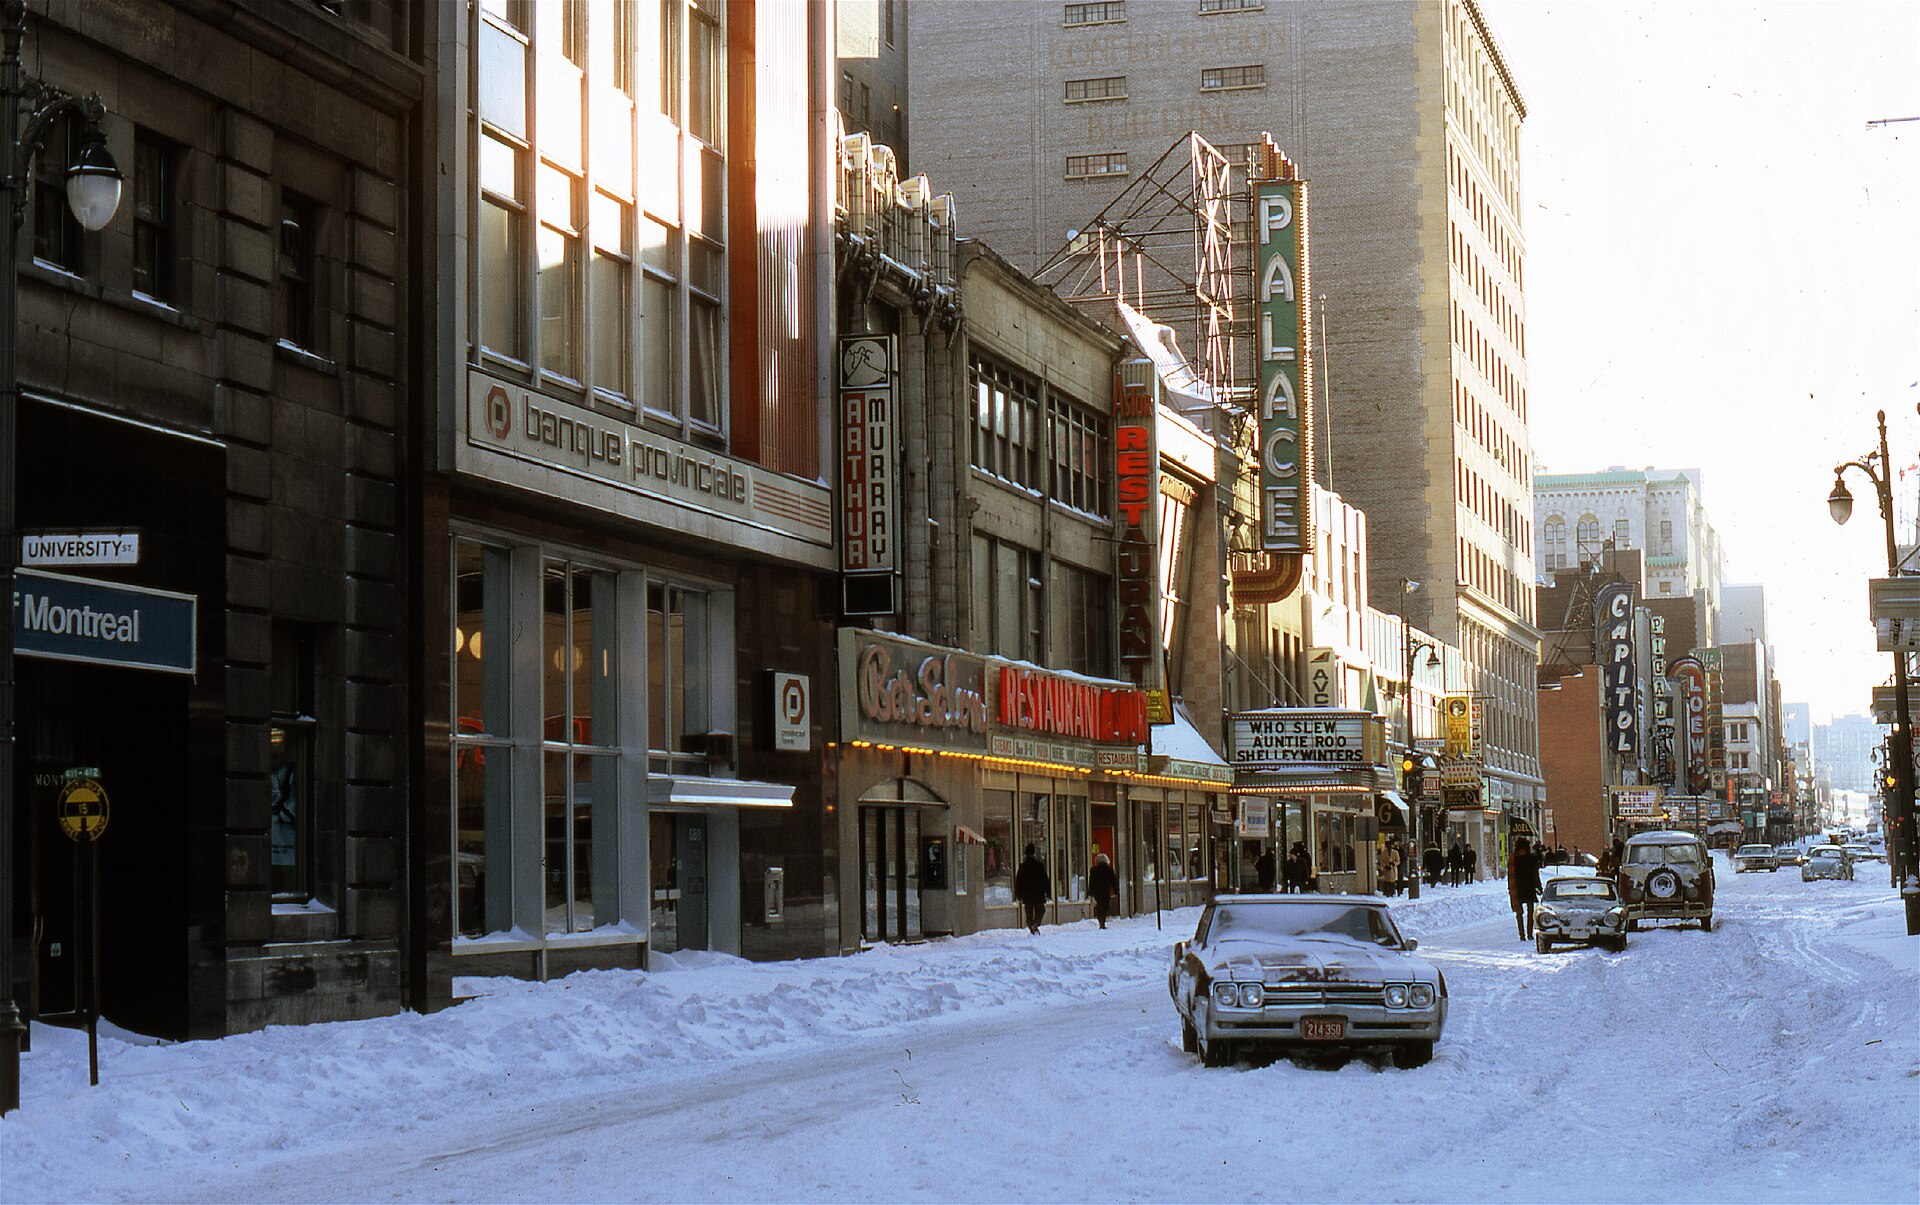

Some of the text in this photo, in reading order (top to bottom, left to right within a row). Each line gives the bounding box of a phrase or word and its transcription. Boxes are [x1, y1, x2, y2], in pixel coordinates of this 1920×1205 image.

[1258, 194, 1298, 537] PALACE
[1112, 371, 1153, 417] ASTOR
[523, 393, 746, 505] banque provinciale
[846, 398, 862, 565] ARTHUR
[868, 397, 886, 563] MURRAY
[28, 540, 122, 558] UNIVERSITY
[23, 594, 139, 643] Montreal
[859, 643, 988, 734] Bar Salon
[1312, 668, 1329, 708] AVC
[1610, 593, 1633, 752] CAPITOL
[1006, 667, 1102, 741] RESTAURANT
[1250, 721, 1336, 734] WHO SLEW
[1098, 752, 1137, 765] RESTAURANT
[1237, 749, 1364, 762] SHELLEY WINTERS
[1253, 735, 1347, 748] AUNTIE ROO
[1512, 823, 1530, 832] JOEL
